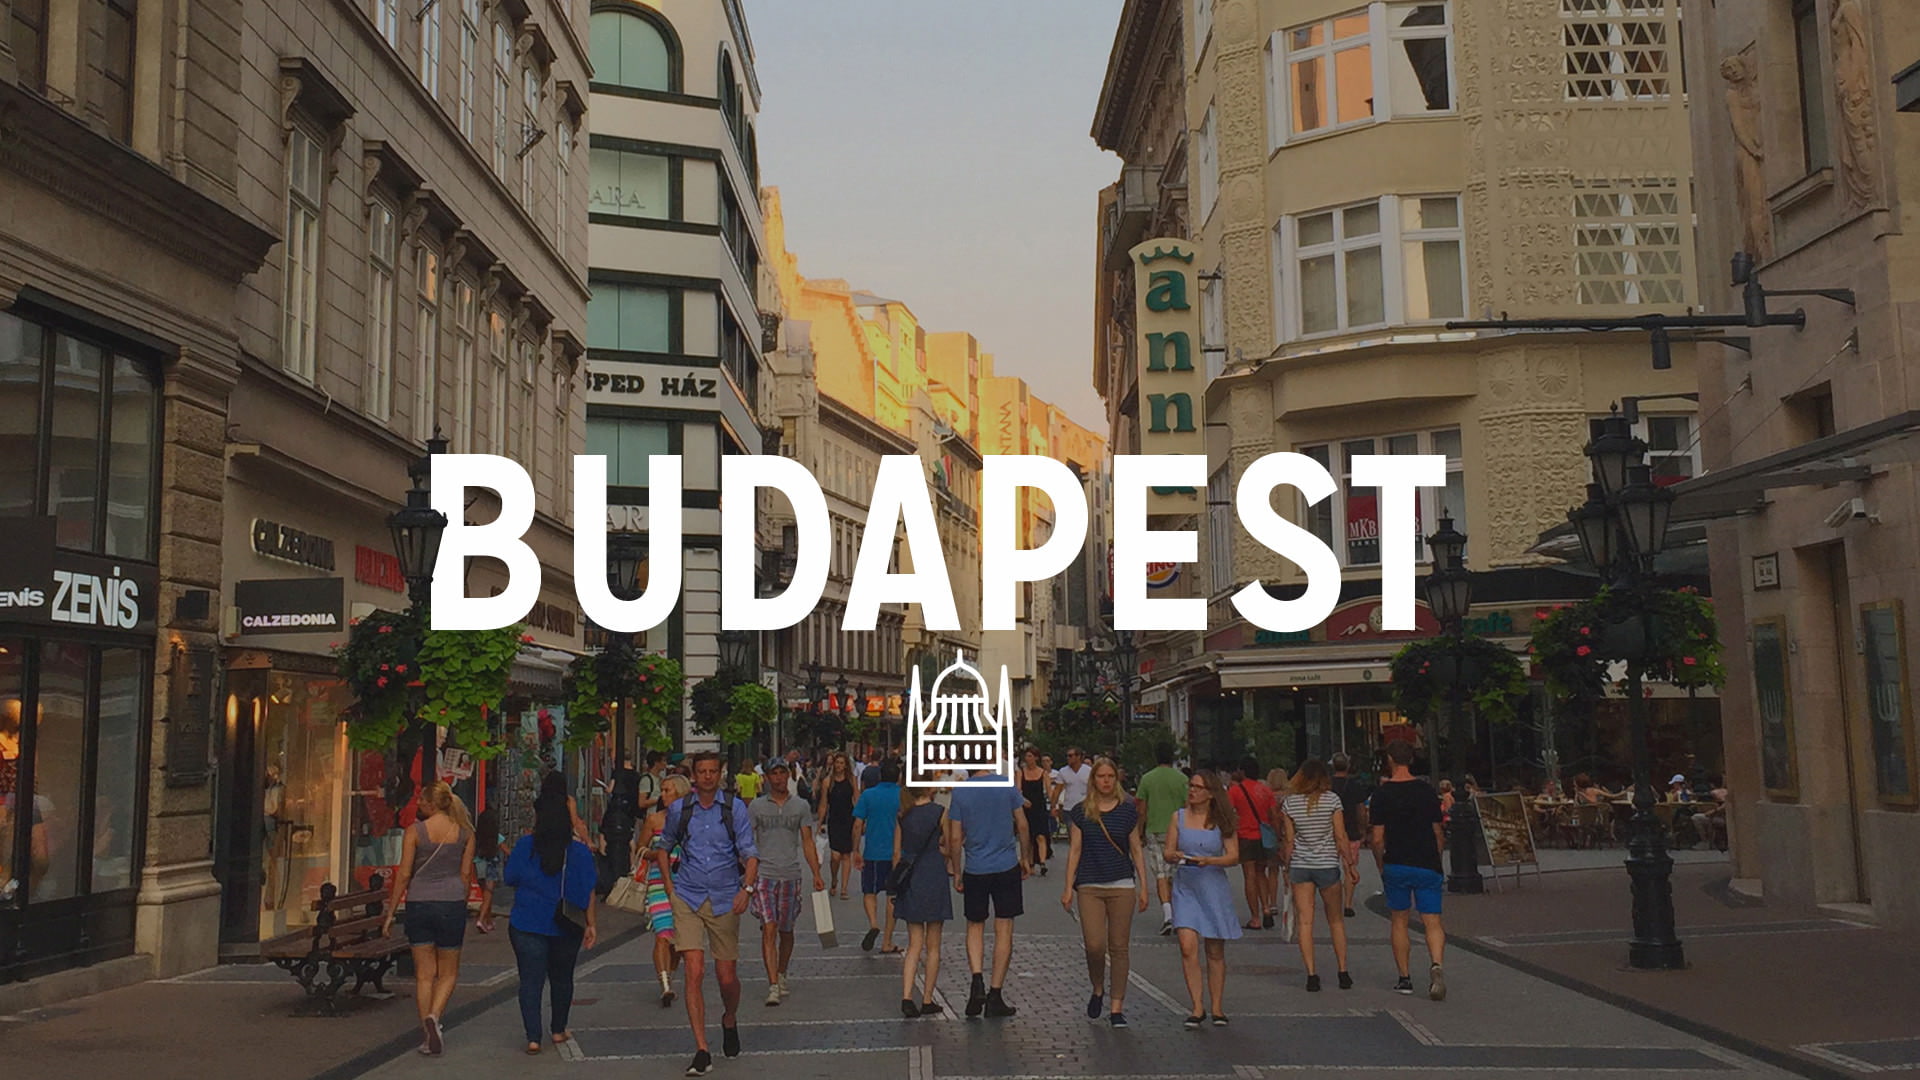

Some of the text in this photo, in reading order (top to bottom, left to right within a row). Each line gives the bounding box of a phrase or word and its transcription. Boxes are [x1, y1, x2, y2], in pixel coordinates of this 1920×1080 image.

[660, 371, 716, 398] HÁZ
[1349, 517, 1377, 538] MKB
[250, 516, 336, 572] CALZEDONIA
[243, 612, 337, 628] CALZEDONIA
